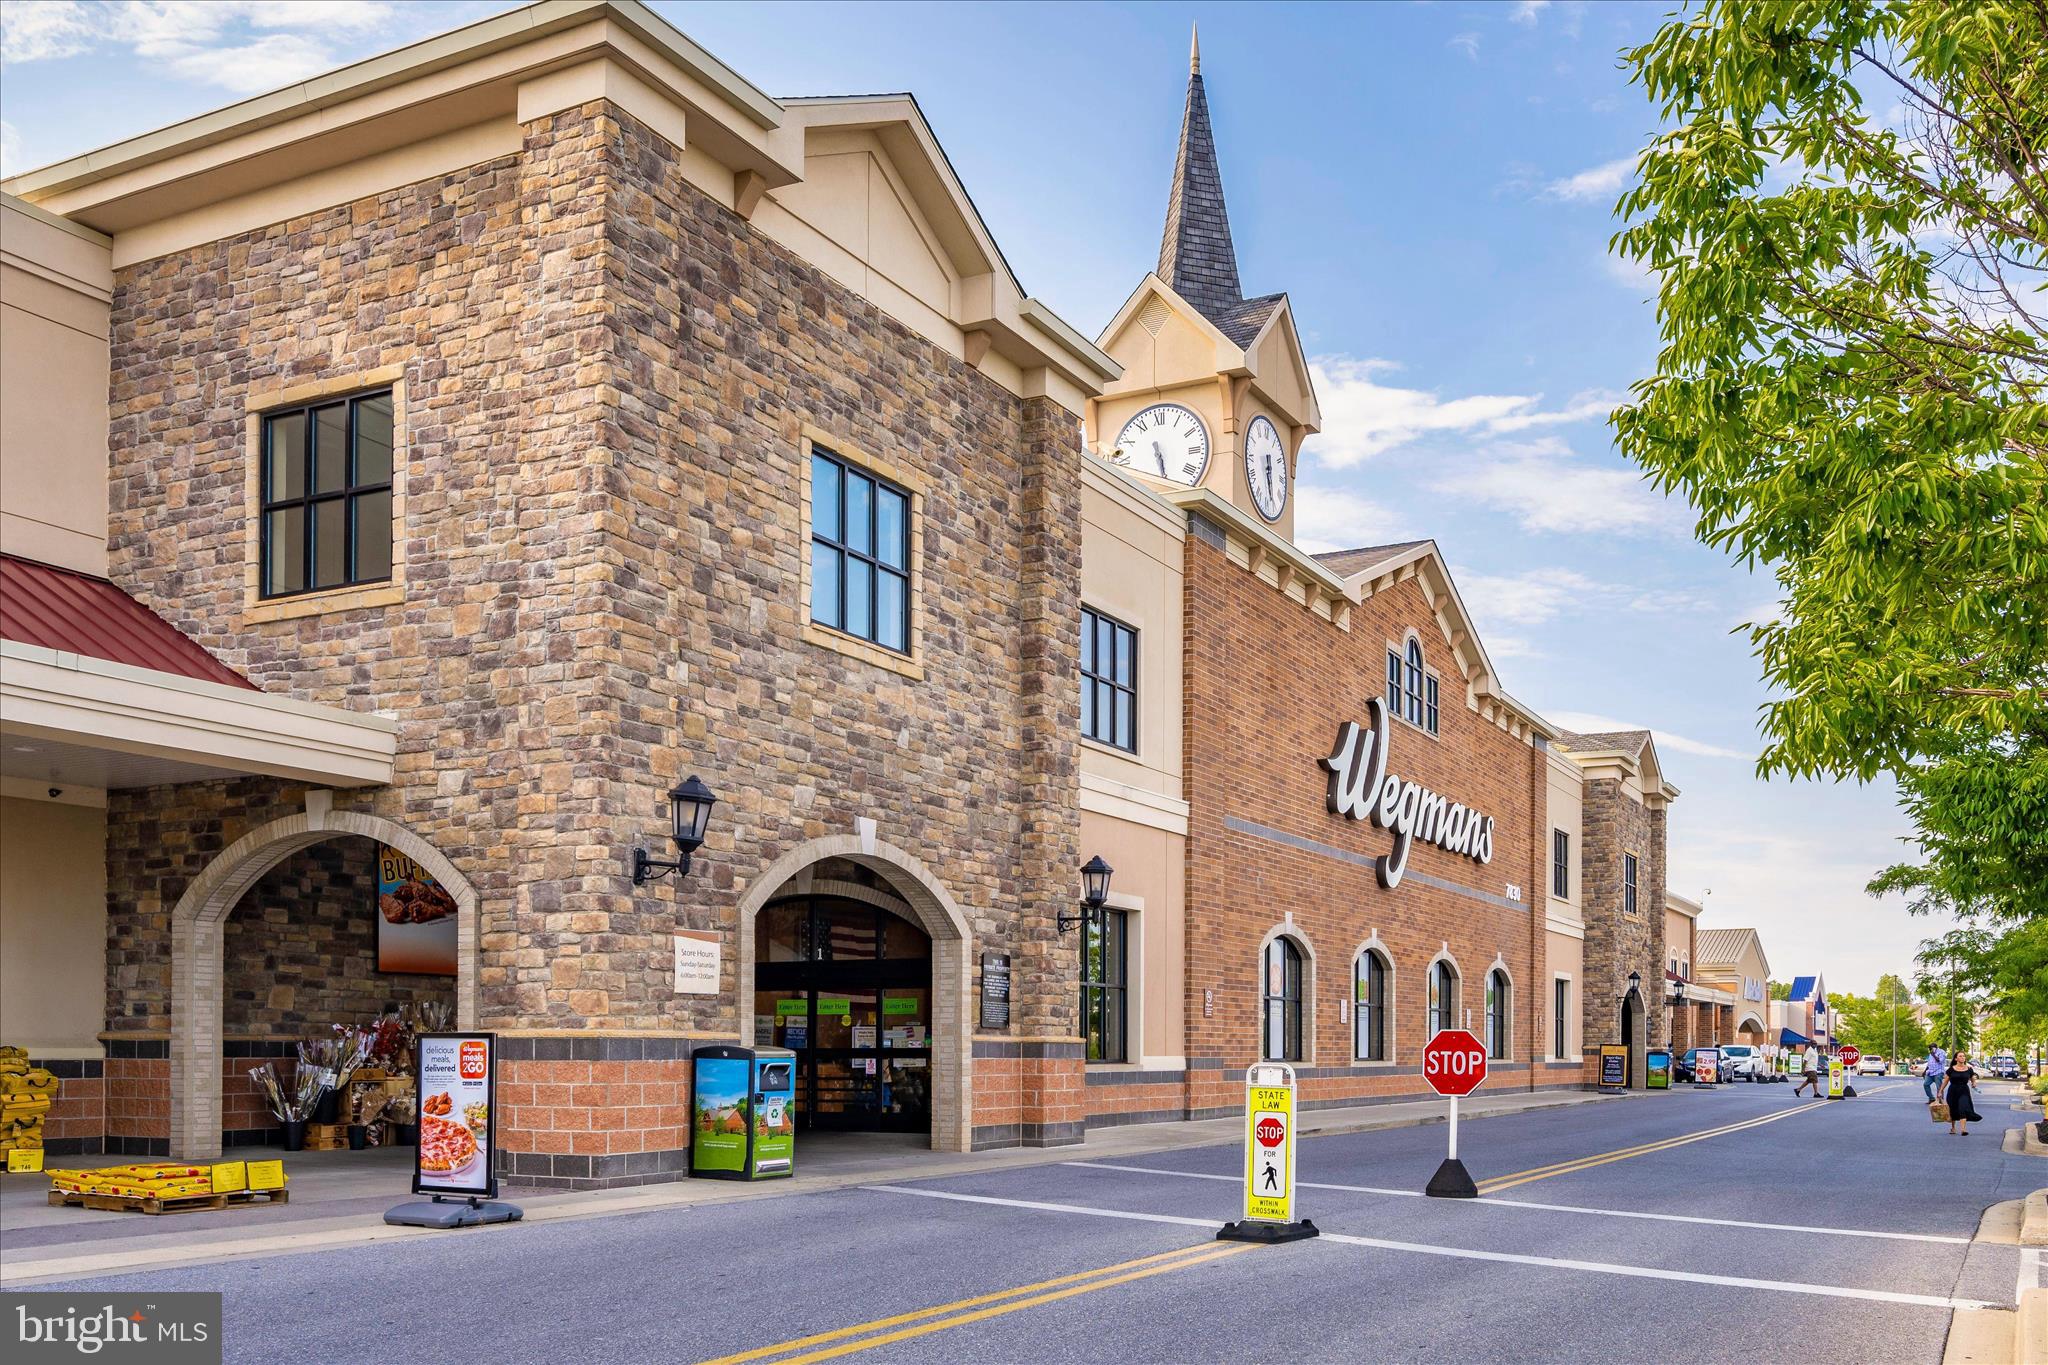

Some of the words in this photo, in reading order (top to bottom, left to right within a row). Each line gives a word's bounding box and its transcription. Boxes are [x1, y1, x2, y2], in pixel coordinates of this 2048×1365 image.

[1325, 697, 1494, 888] Wegmans
[681, 949, 696, 957] Store
[817, 947, 823, 960] 1
[426, 1045, 454, 1054] delicious
[463, 1053, 484, 1062] meals
[1840, 1051, 1859, 1060] STOP
[463, 1062, 484, 1073] 2GO
[1427, 1051, 1483, 1075] STOP
[424, 1064, 456, 1072] delivered
[1258, 1091, 1284, 1100] STATE
[1262, 1101, 1280, 1109] LAW
[1257, 1126, 1284, 1139] STOP
[1252, 1206, 1285, 1216] CROSSWALK
